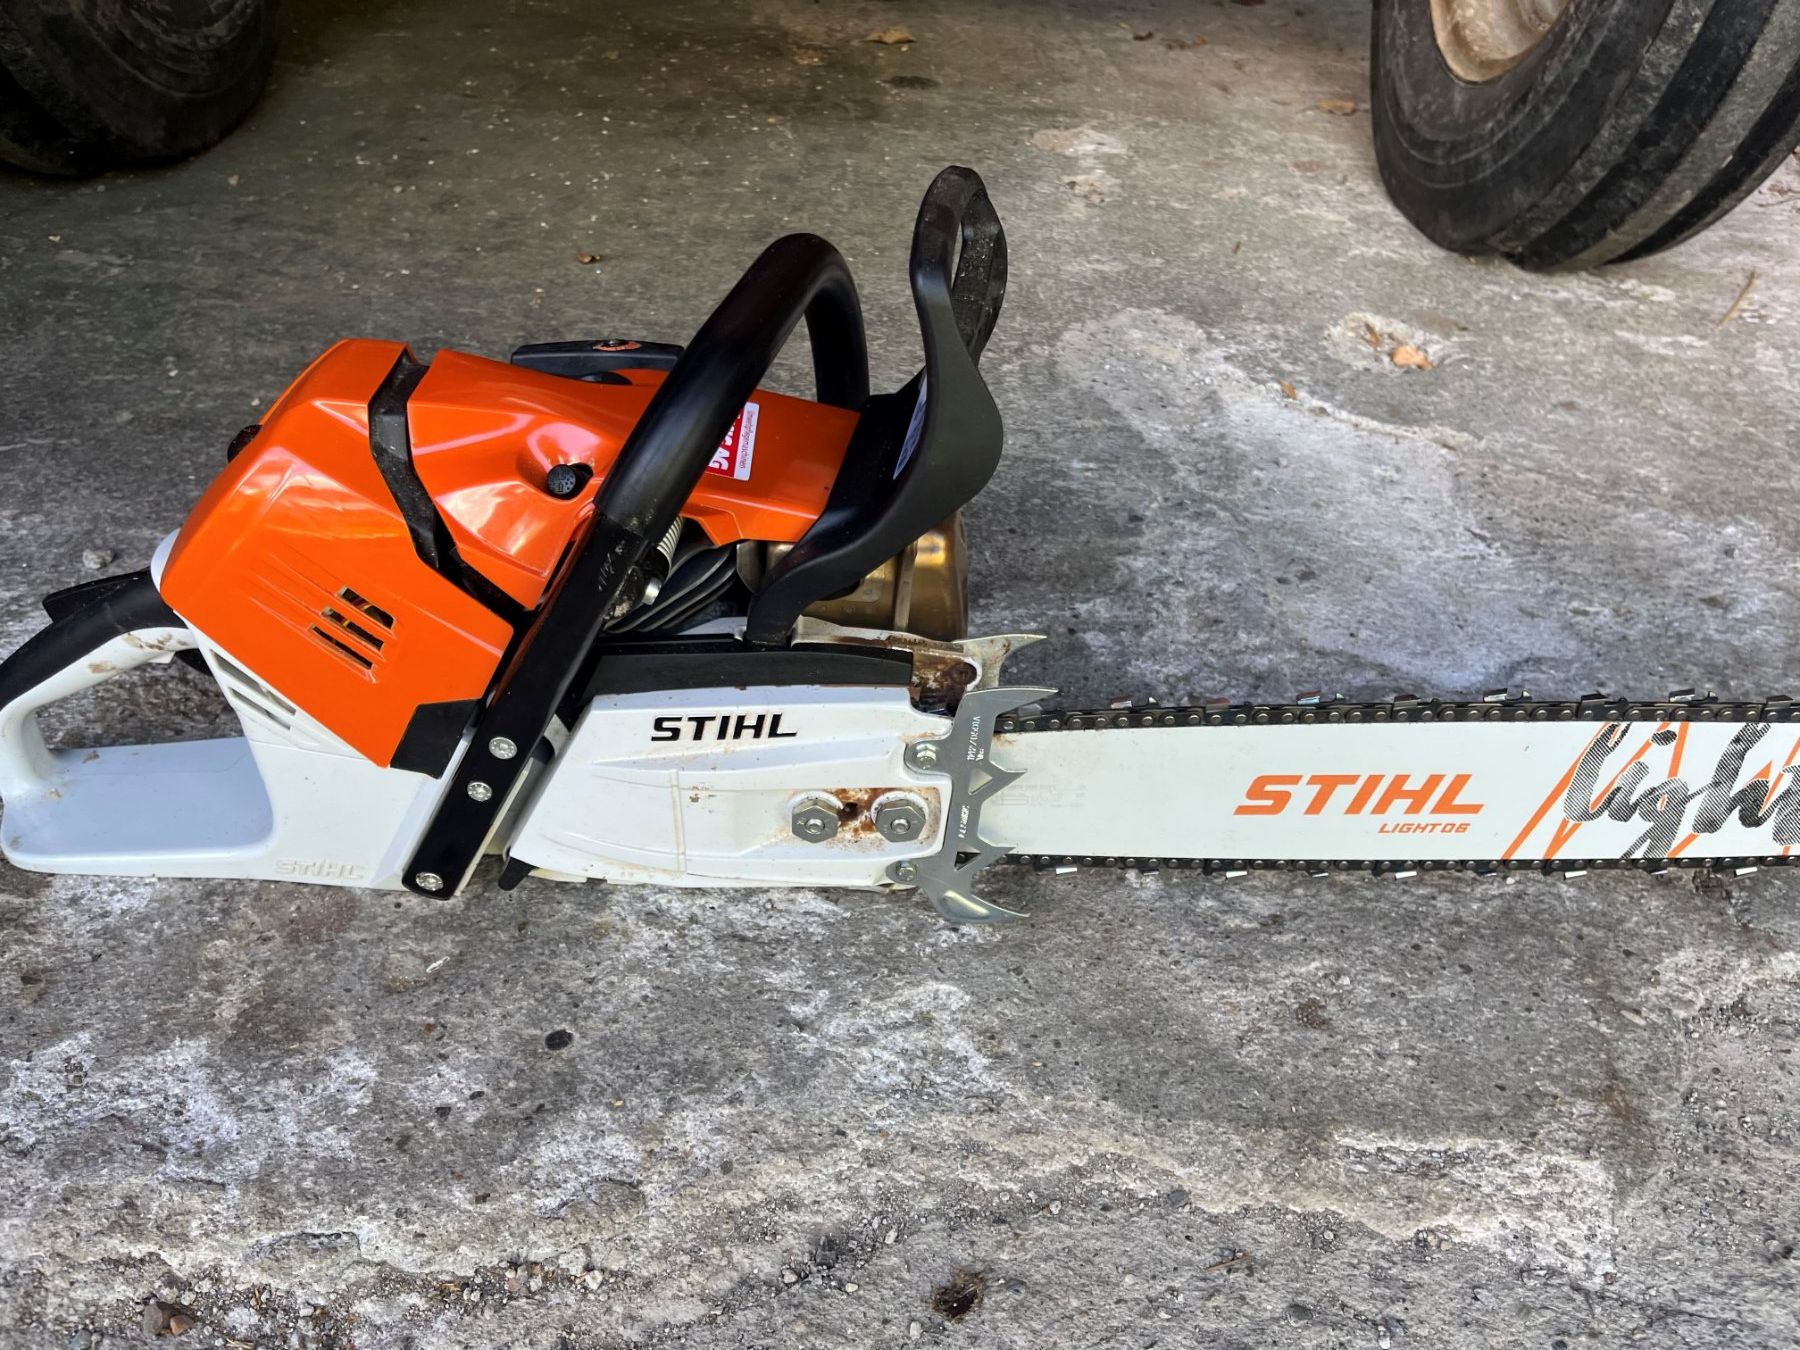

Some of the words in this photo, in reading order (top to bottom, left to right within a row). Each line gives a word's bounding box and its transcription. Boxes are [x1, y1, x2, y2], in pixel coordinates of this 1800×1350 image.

[651, 713, 797, 741] STIHL
[1233, 774, 1485, 815] STIHL
[275, 859, 364, 879] STIHL
